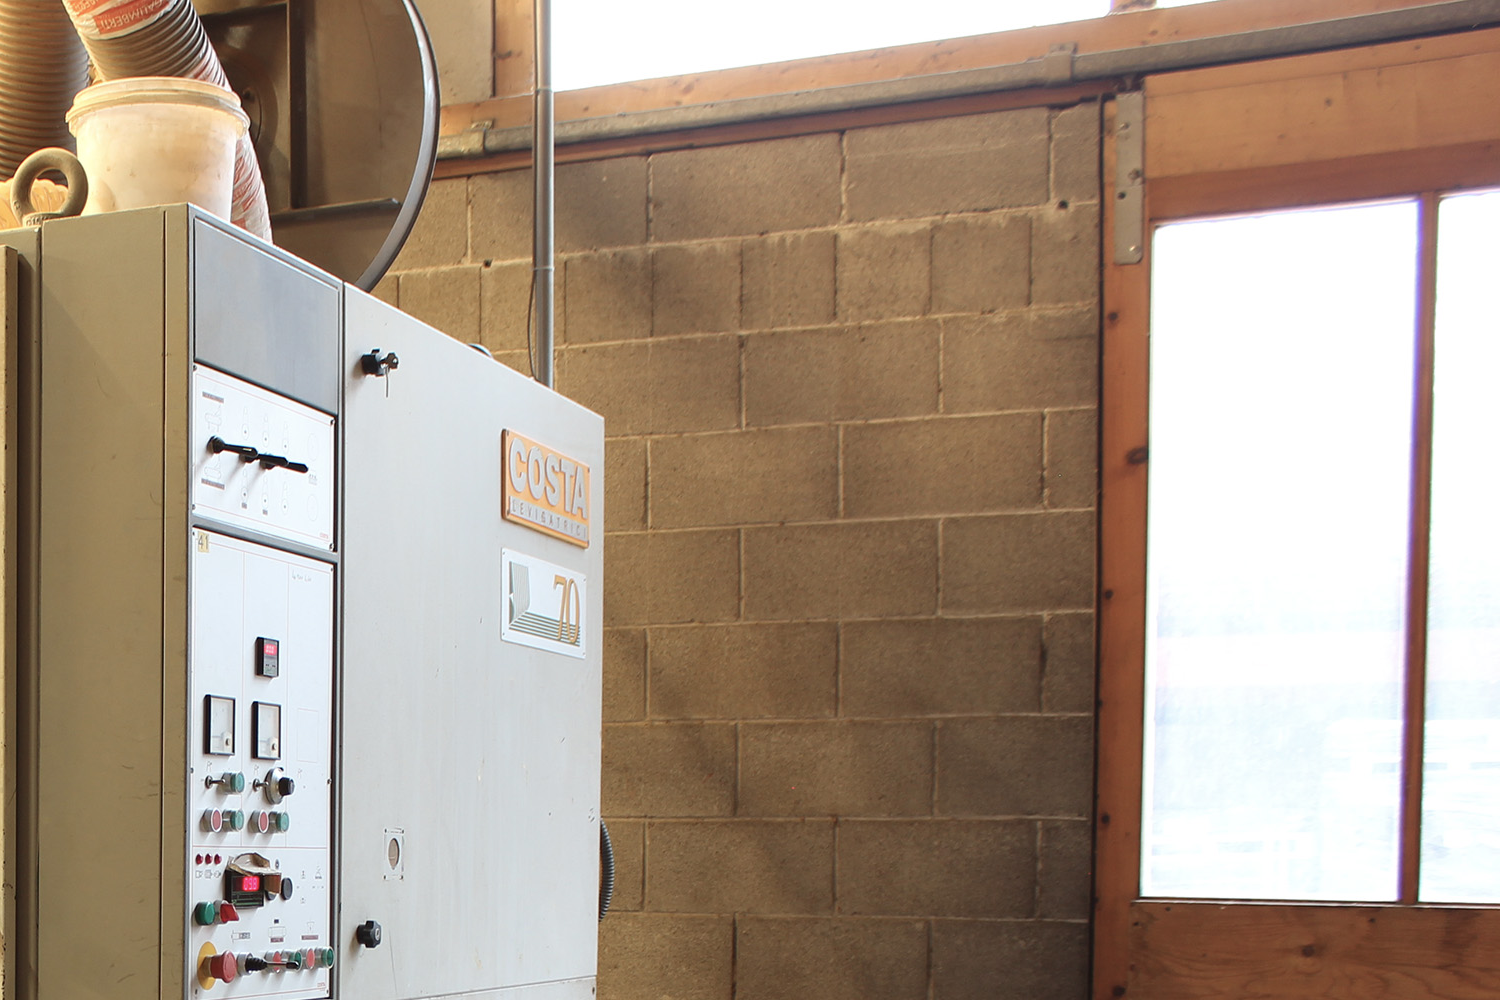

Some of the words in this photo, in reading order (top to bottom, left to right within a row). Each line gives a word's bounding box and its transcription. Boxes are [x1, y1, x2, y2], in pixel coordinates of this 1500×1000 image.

[509, 437, 588, 520] COSTA
[197, 534, 209, 550] 41
[512, 499, 587, 539] LEVIGATRICI
[553, 574, 580, 643] 70
